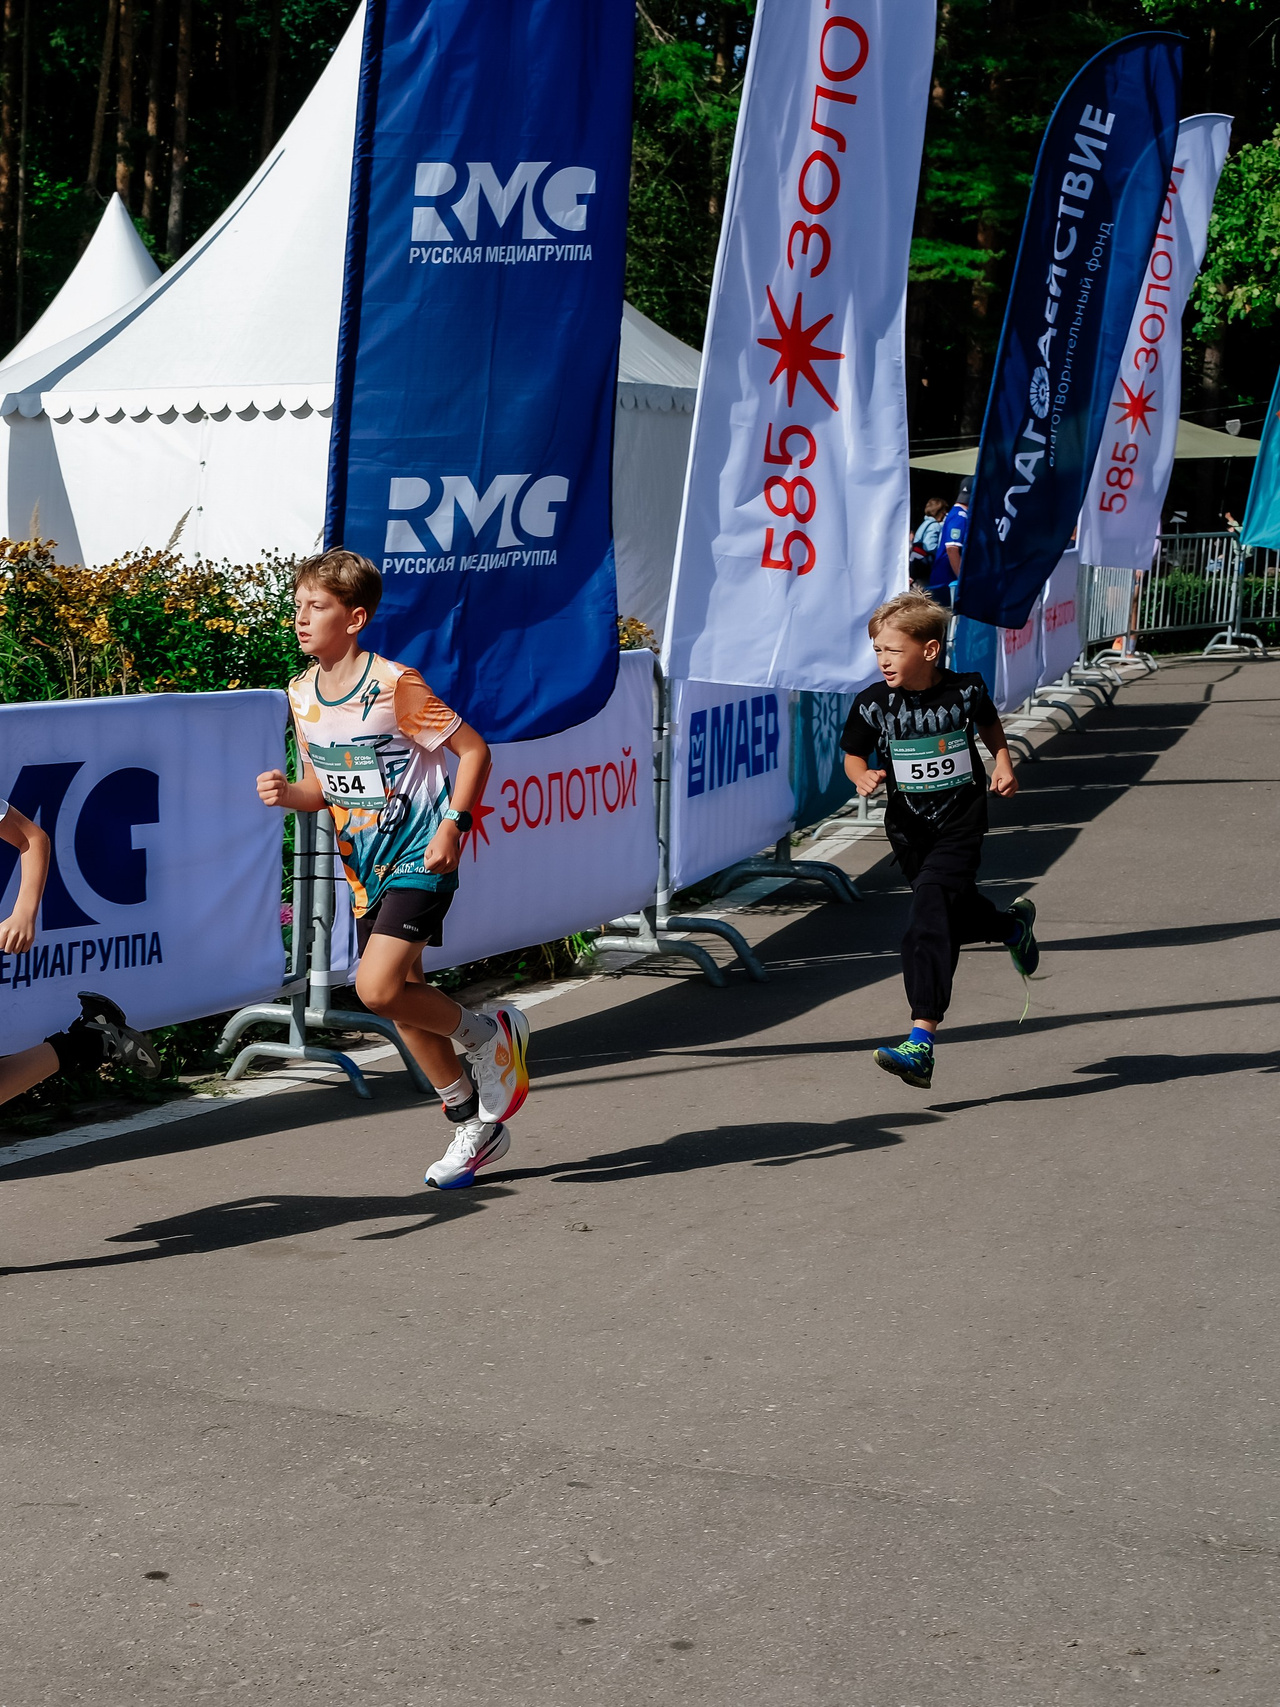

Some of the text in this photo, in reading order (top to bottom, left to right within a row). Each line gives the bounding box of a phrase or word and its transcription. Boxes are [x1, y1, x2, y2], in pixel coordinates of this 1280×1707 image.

[411, 161, 597, 242] RMG
[408, 244, 593, 265] РУССКАЯ МЕДИАГРУППА
[1085, 222, 1115, 272] фонд
[761, 0, 869, 576] 585 ЗОЛО
[384, 473, 570, 553] RMG
[1099, 441, 1139, 515] 585
[382, 549, 558, 575] РУССКАЯ МЕДИАГРУППА
[709, 693, 780, 791] MAER
[911, 758, 955, 780] 559
[326, 774, 366, 794] 554
[500, 746, 638, 834] ЗОЛОТОЙ
